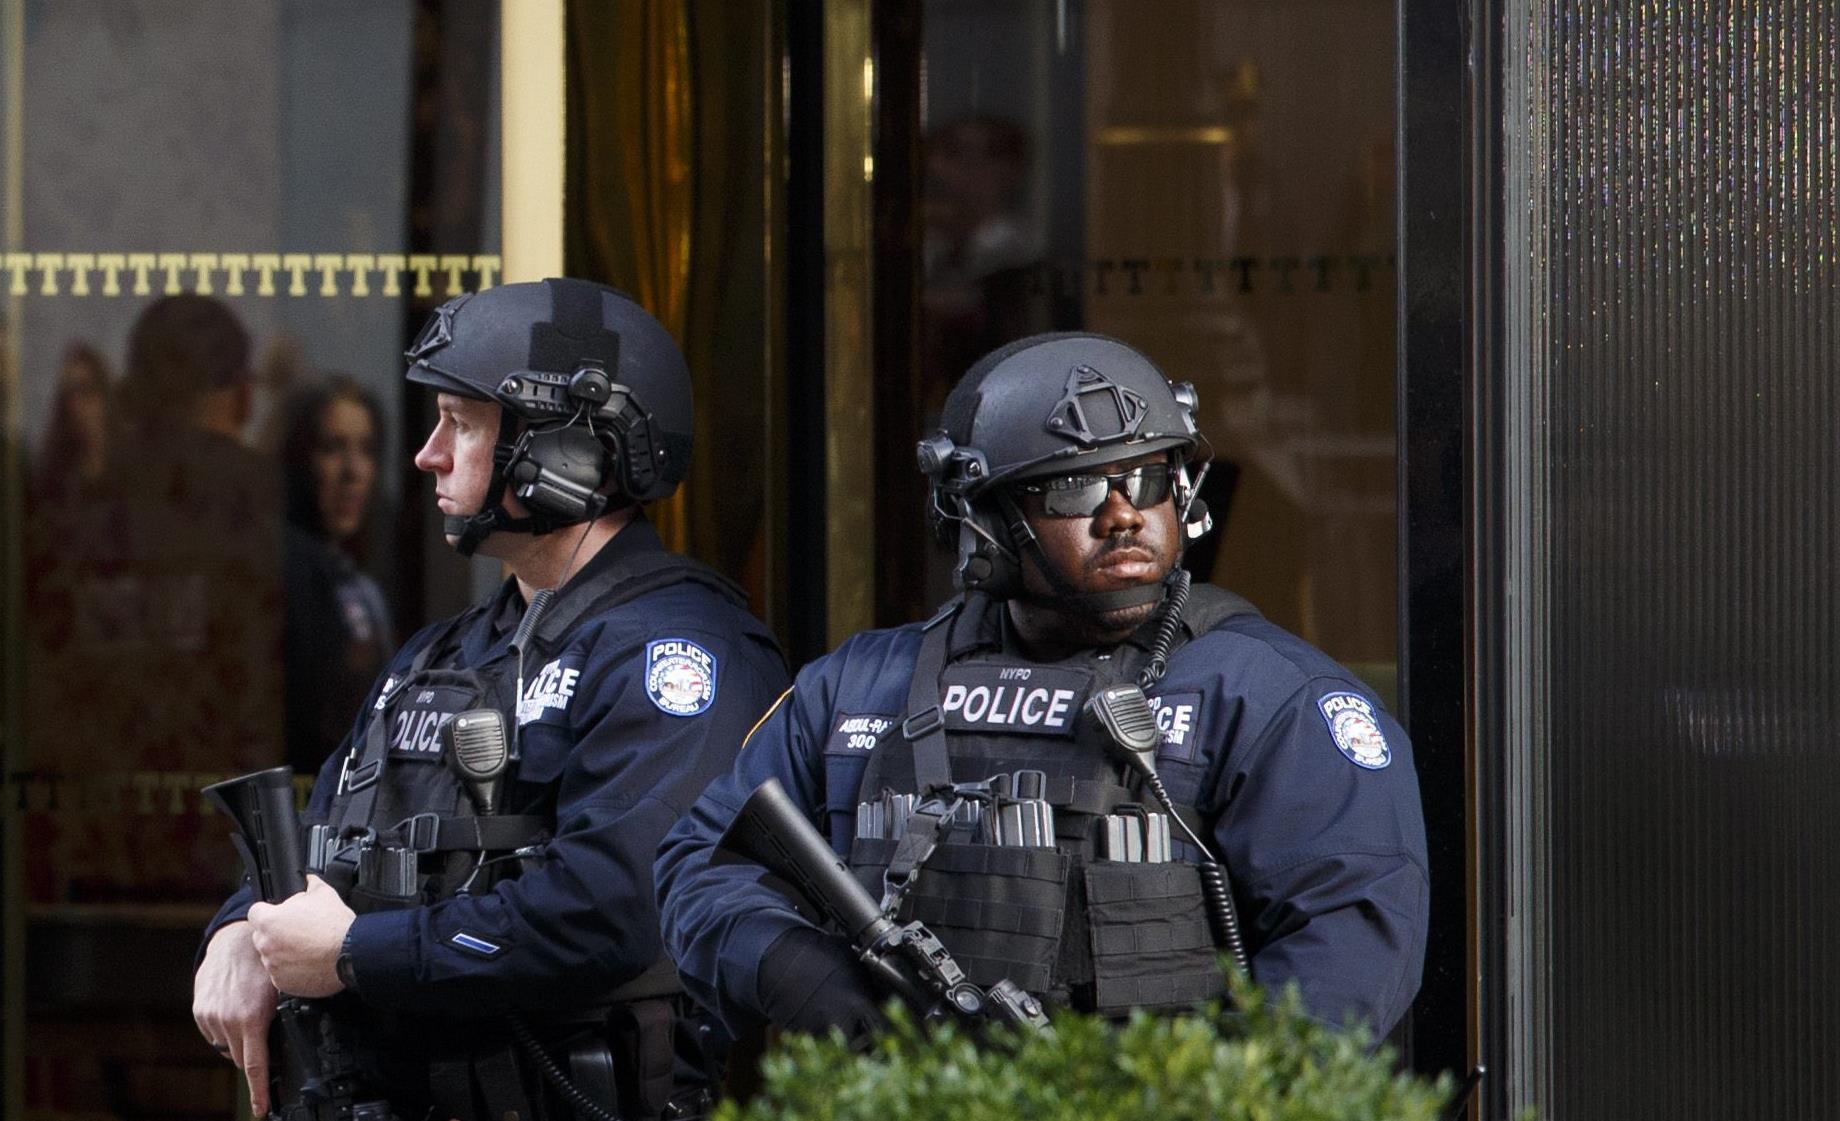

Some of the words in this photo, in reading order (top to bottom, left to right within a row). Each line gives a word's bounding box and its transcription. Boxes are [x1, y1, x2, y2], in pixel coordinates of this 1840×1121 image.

[652, 642, 712, 674] POLICE
[999, 668, 1032, 681] NYPD
[943, 685, 1075, 727] POLICE
[1323, 696, 1376, 723] POLICE
[390, 710, 454, 752] OLICE
